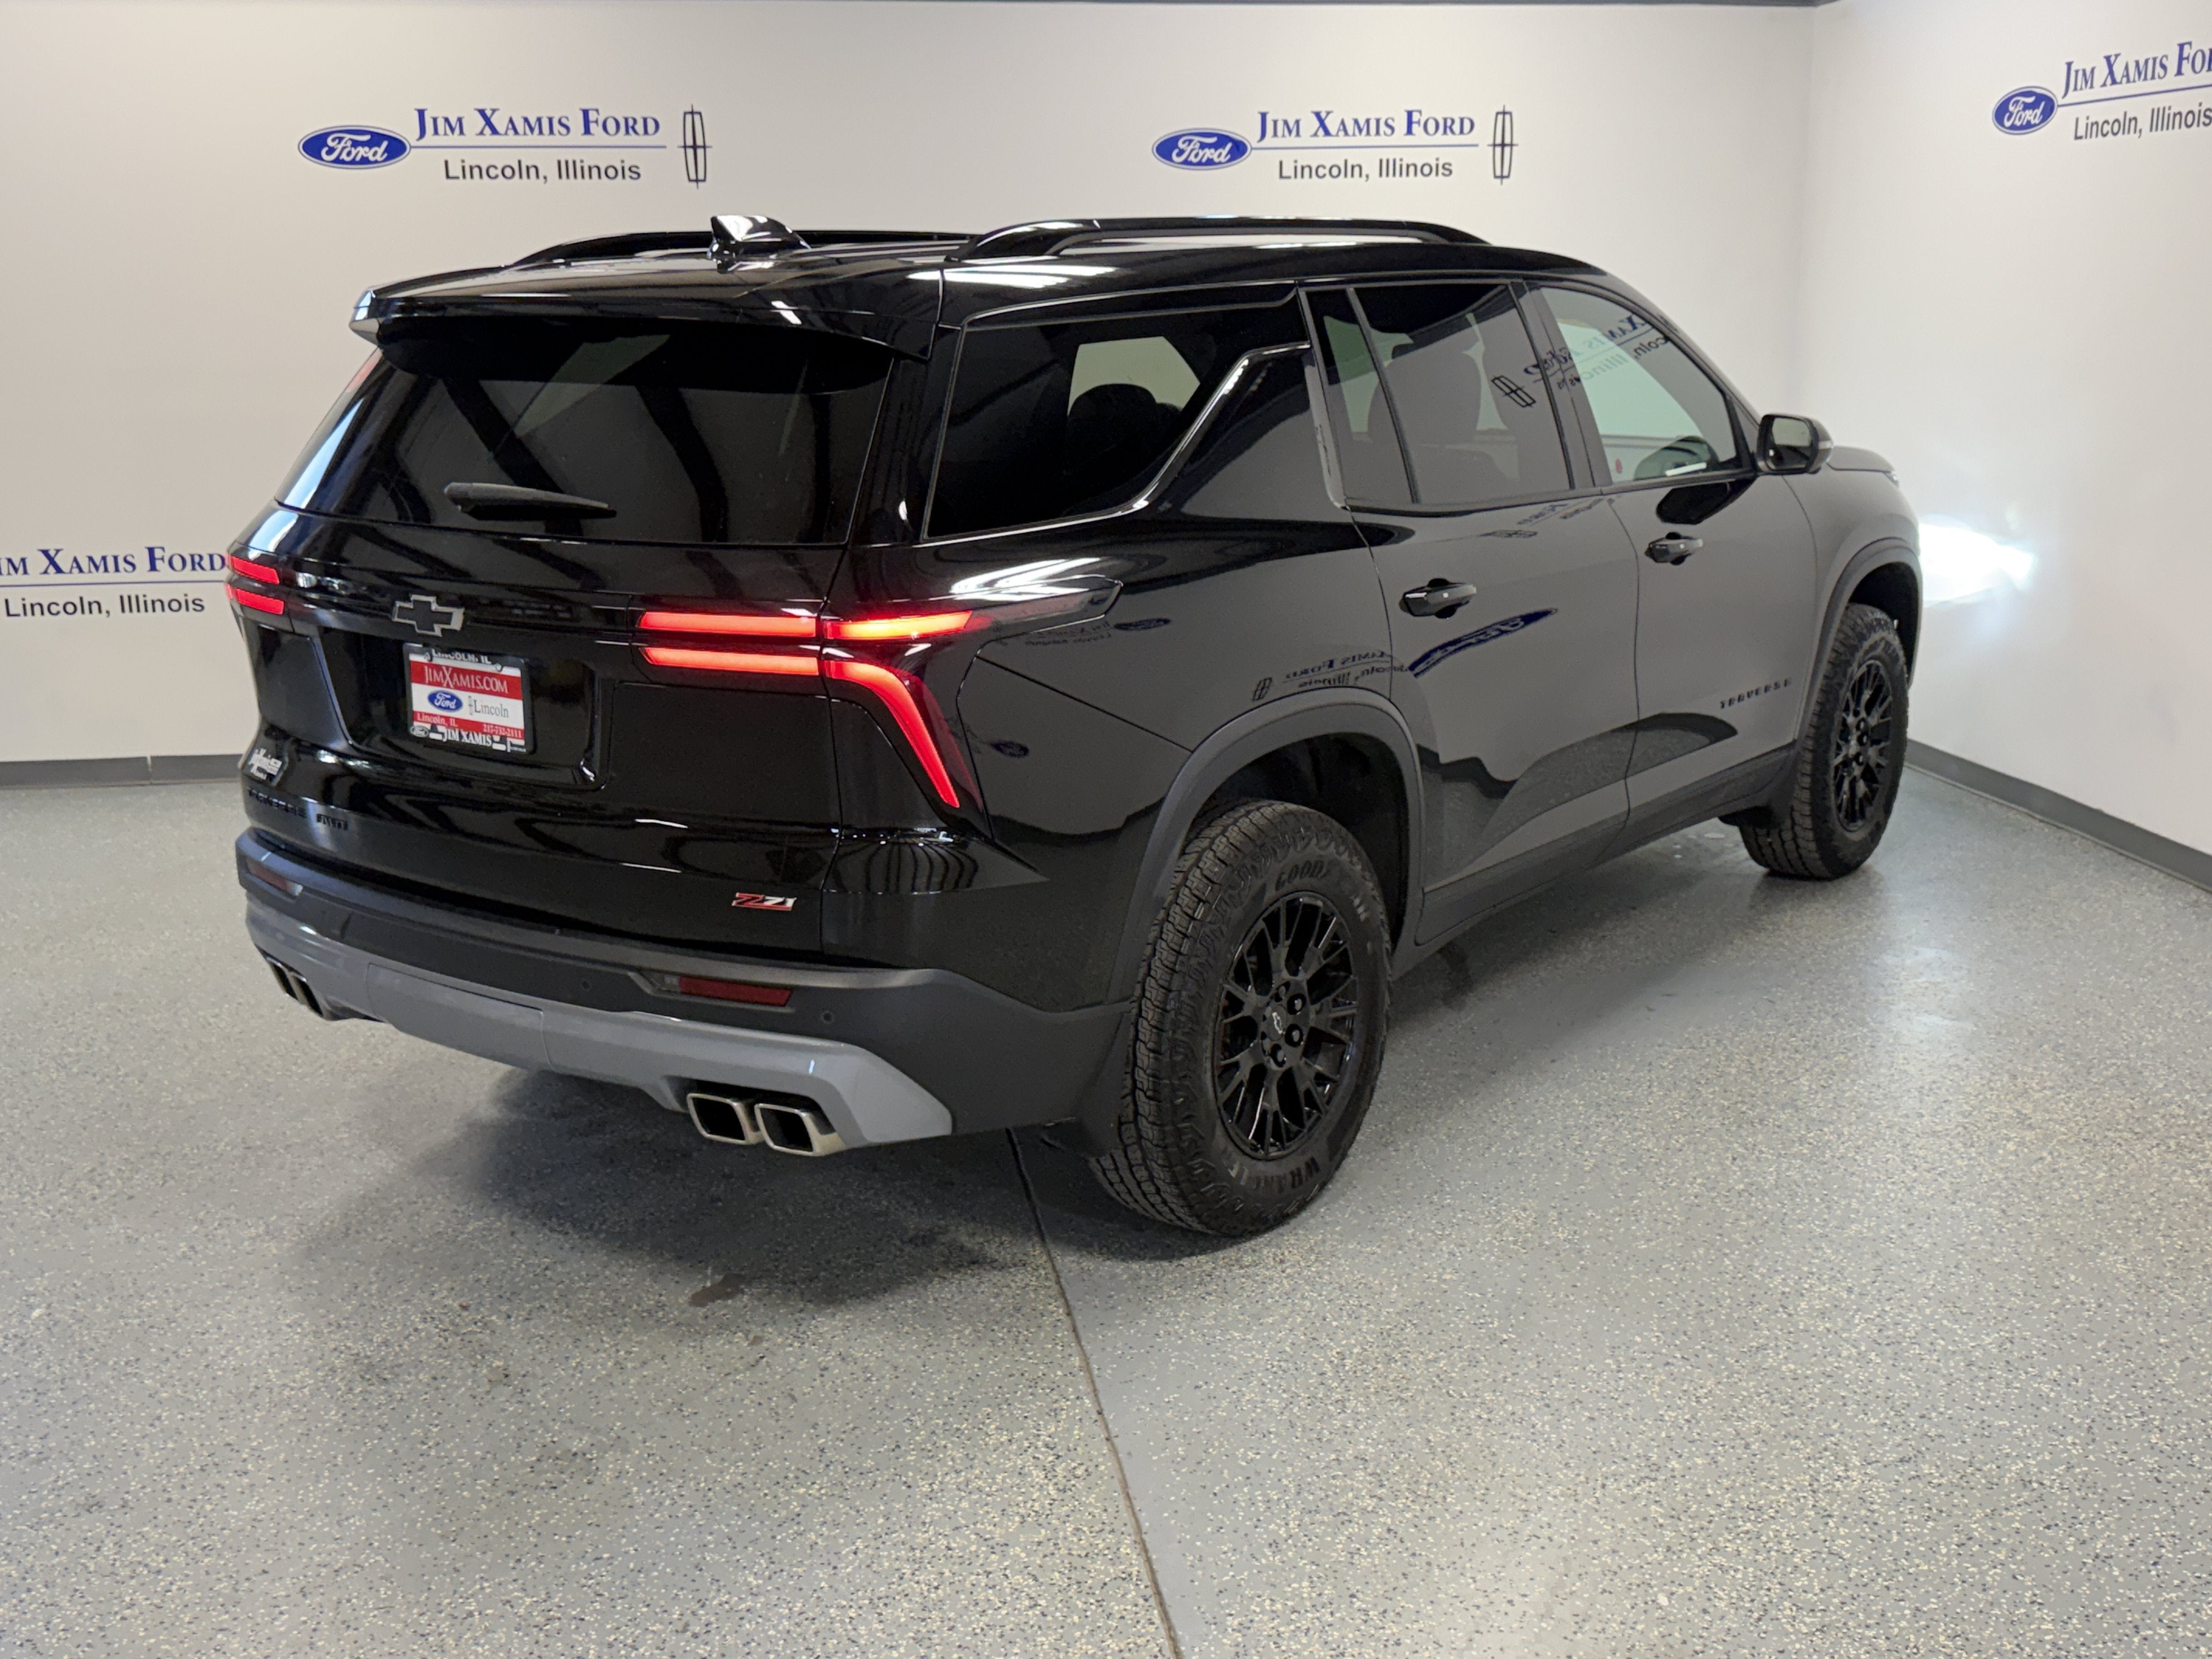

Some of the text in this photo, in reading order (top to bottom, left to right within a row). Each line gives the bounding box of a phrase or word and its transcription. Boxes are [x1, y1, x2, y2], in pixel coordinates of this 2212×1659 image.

[2062, 41, 2212, 99] JIM XAMIS FO
[414, 108, 660, 142] JIM XAMIS FORD
[1257, 110, 1475, 143] JIM XAMIS FORD
[2074, 102, 2212, 140] Lincoln, Illinois
[444, 159, 641, 184] Lincoln, Illinois
[1279, 157, 1453, 182] Lincoln, Illinois
[37, 549, 137, 575] XAMIS
[145, 546, 227, 572] FORD
[4, 593, 205, 617] Lincoln, Illinois
[424, 665, 509, 694] JIMXAMIS.COM
[416, 713, 448, 725] Lincoln,
[449, 718, 459, 727] IL
[473, 699, 509, 718] Lincoln
[443, 729, 460, 742] JIM
[462, 731, 492, 747] XAMIS
[731, 891, 797, 911] Z71
